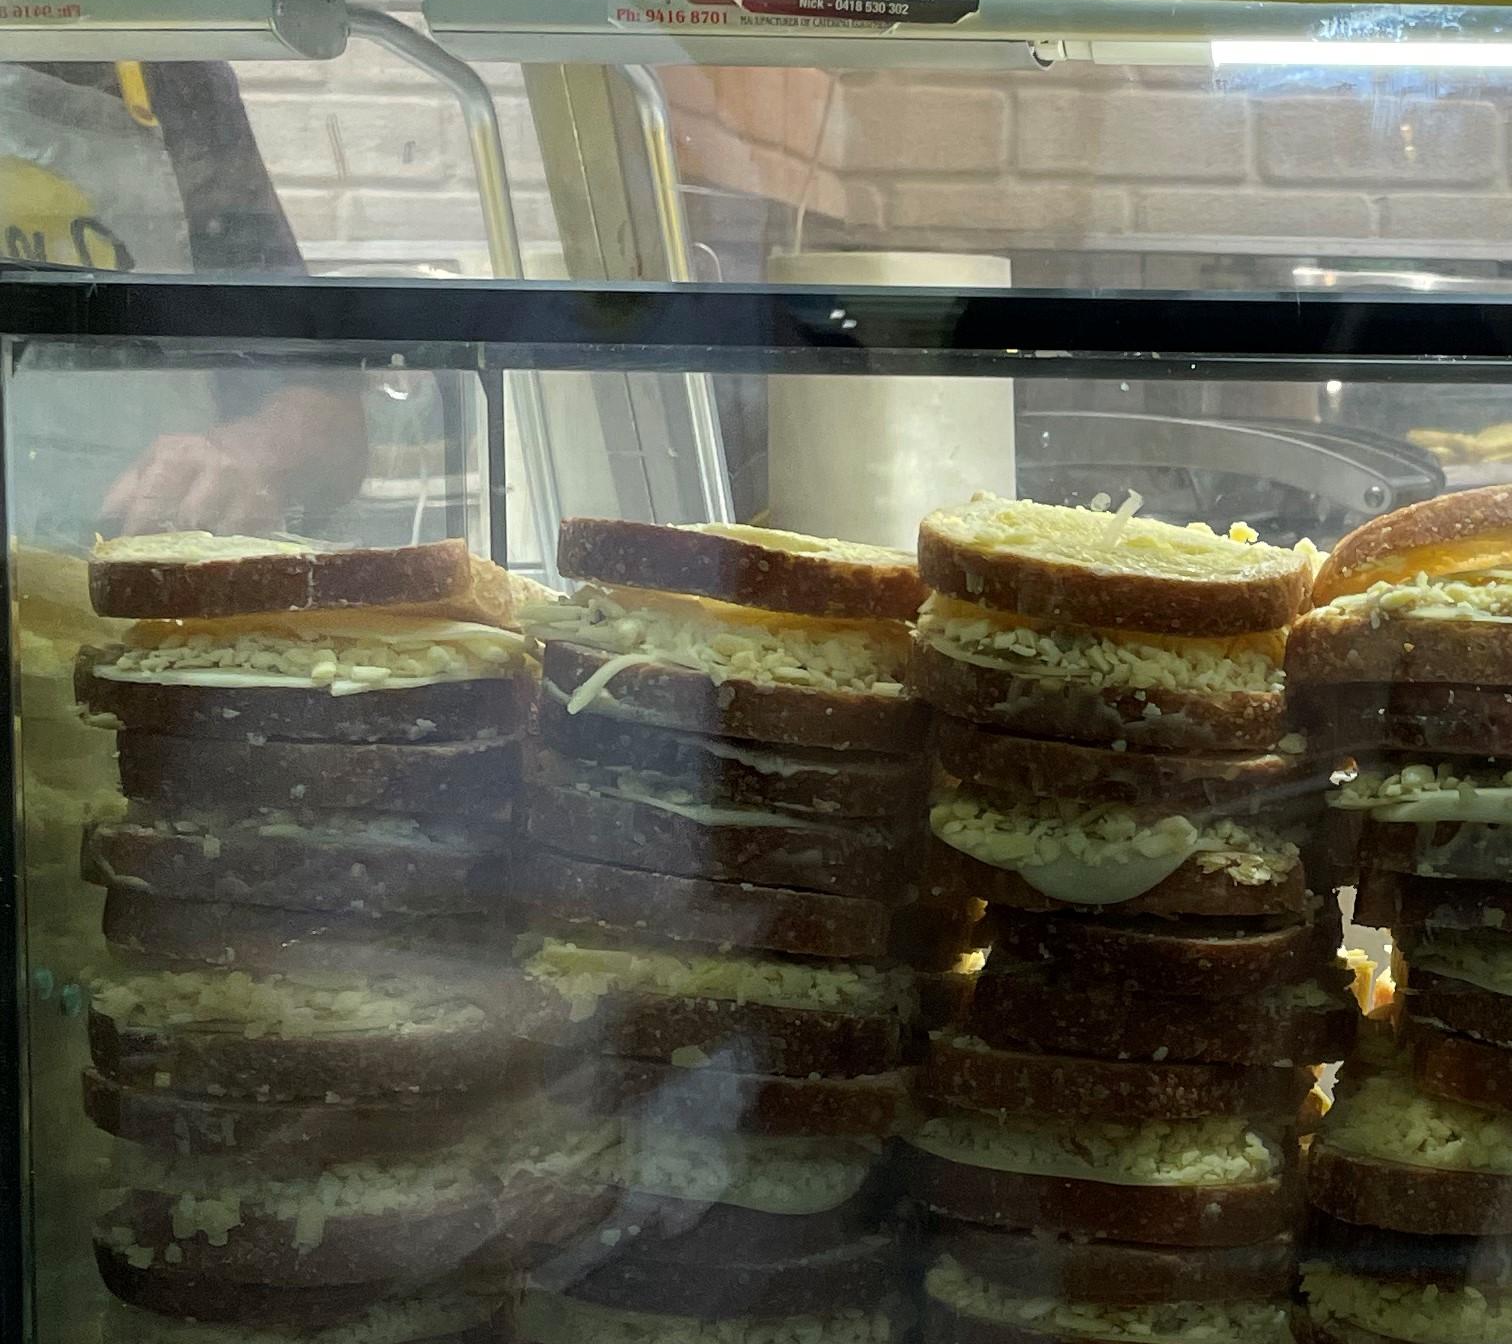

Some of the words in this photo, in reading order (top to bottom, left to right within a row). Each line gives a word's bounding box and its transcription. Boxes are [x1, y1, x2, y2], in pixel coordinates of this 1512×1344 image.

[835, 0, 862, 12] 0418
[865, 1, 886, 14] 530
[888, 2, 909, 15] 302
[616, 8, 641, 22] Ph:
[645, 8, 686, 24] 9416
[690, 10, 728, 25] 8701
